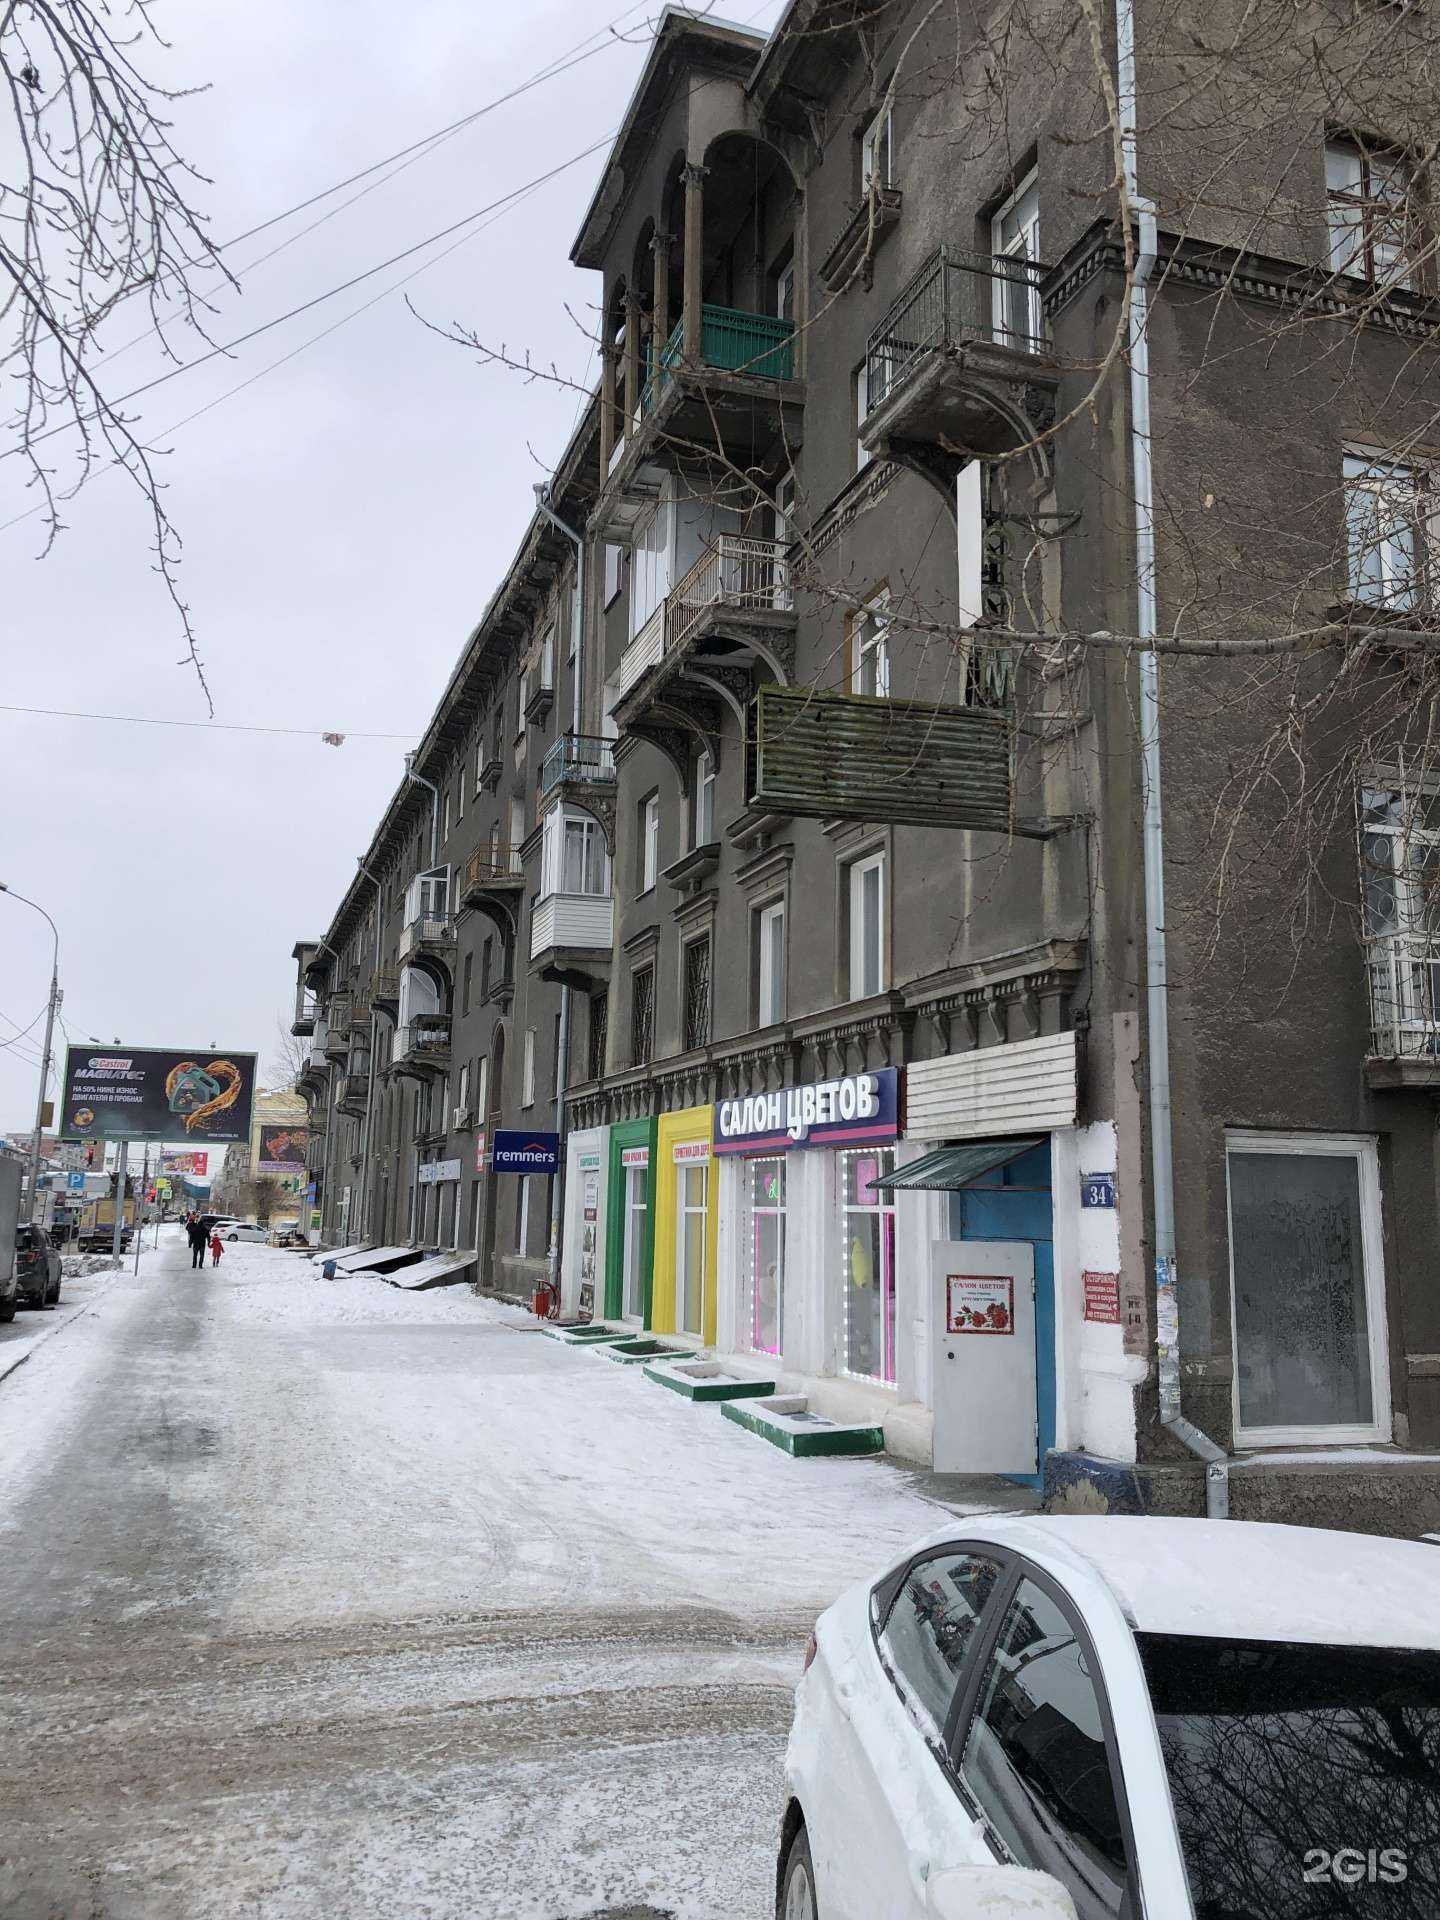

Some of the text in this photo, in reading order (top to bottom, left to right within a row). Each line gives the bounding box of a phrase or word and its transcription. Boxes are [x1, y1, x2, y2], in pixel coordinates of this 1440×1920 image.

[99, 1060, 128, 1068] Castrol
[74, 1069, 145, 1080] MAGNATEC
[72, 1093, 108, 1101] ДВИГАТЕЛЯ
[720, 1075, 879, 1140] САЛОН ЦВЕТОВ
[496, 1151, 555, 1162] remmers
[1090, 1185, 1106, 1204] 34
